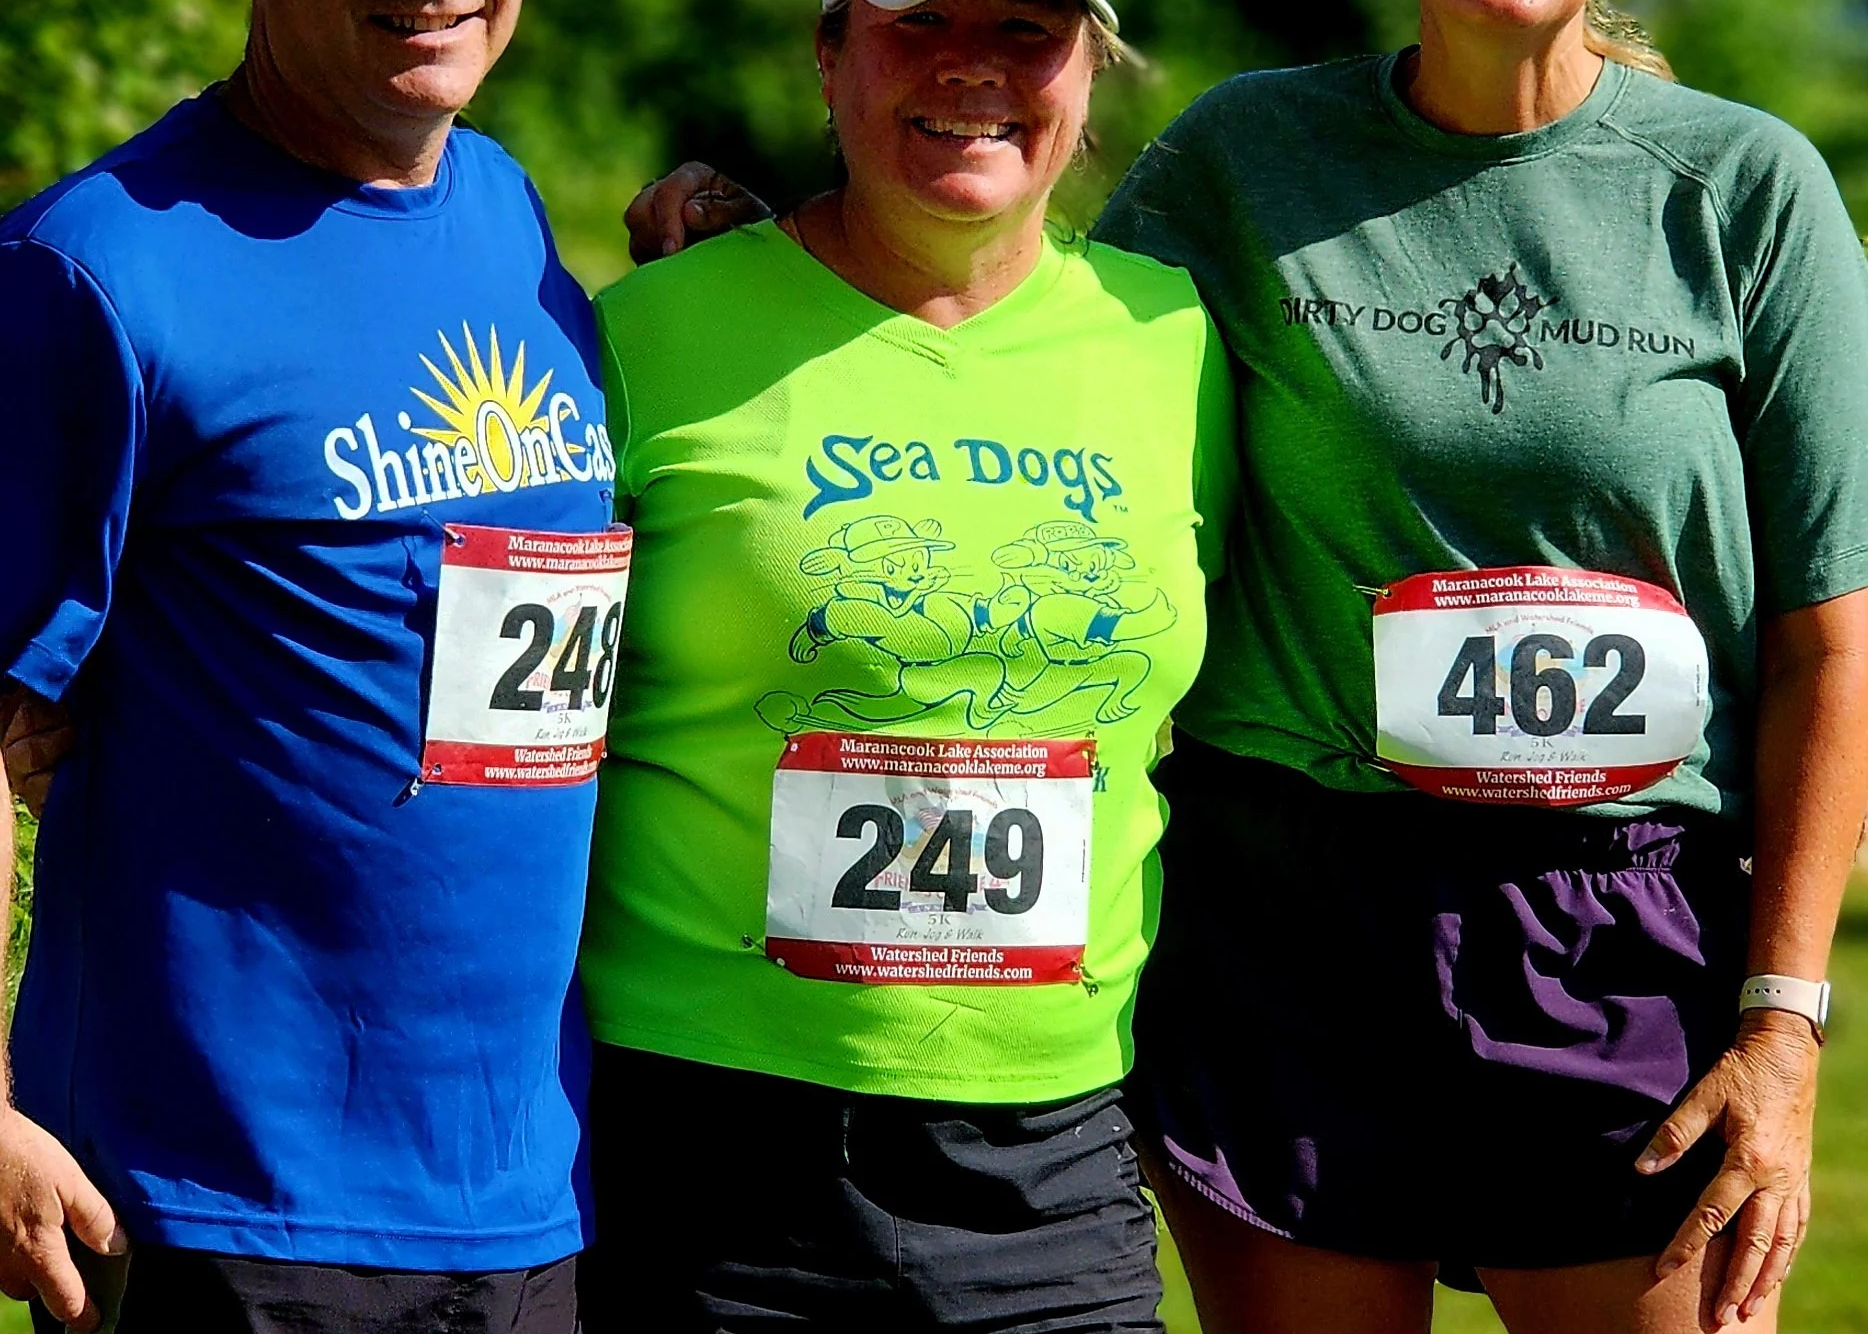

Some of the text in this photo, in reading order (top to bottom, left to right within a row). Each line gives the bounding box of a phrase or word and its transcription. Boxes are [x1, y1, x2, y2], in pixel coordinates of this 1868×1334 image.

[1279, 297, 1447, 337] DIRTY DOG
[1540, 318, 1695, 360] MUD RUN
[803, 434, 1122, 523] Sea Dogs
[508, 536, 584, 555] Maranacook
[1432, 573, 1638, 593] Maranacook Lake Association
[1434, 588, 1640, 608] www.maranacooklakeme.org
[489, 602, 621, 711] 248
[1437, 633, 1647, 737] 462
[840, 738, 1048, 758] Maranacook Lake Association
[1530, 738, 1554, 749] 5K
[514, 747, 567, 763] Watershed
[841, 756, 1046, 778] www.maranacooklakeme.org
[1476, 769, 1606, 784] Watershed Friends
[1442, 783, 1632, 800] www.watershedfriends.com
[831, 804, 1044, 915] 249
[927, 914, 951, 925] 5K
[871, 947, 1004, 964] Watershed Friends
[836, 963, 1033, 979] www.watershedfriends.com
